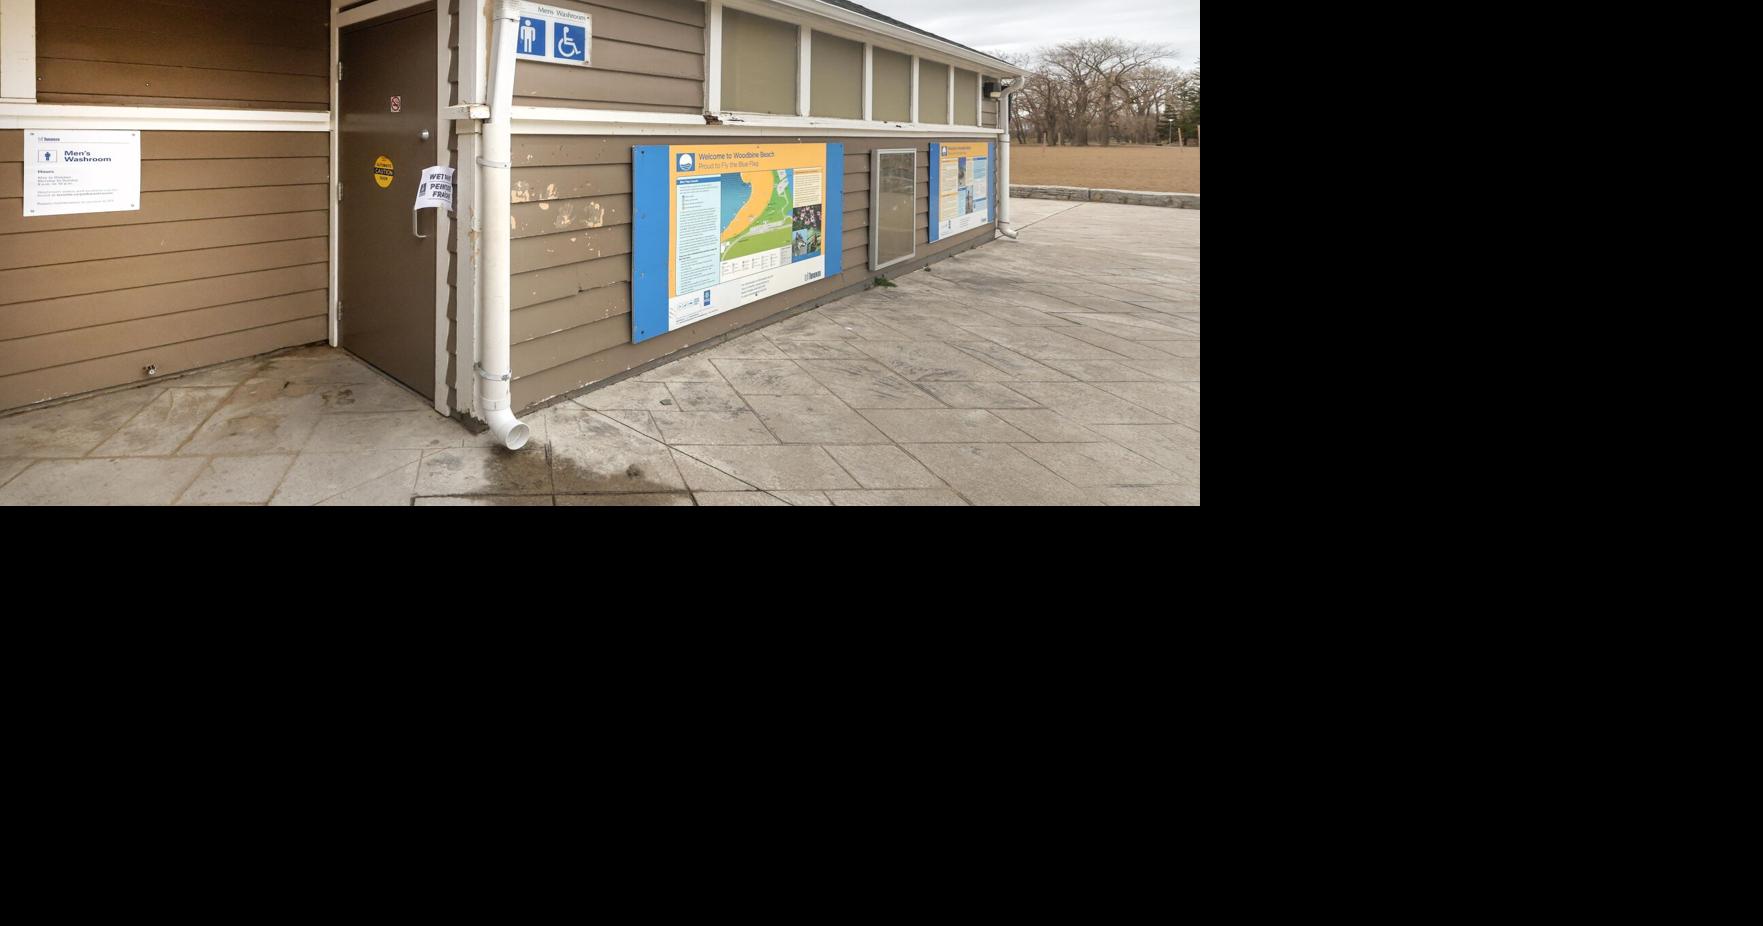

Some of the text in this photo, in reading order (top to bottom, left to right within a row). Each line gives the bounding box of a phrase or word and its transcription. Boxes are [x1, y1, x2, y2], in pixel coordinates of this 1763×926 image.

[698, 152, 725, 160] Welcome
[734, 151, 759, 159] Woodbine
[375, 167, 393, 176] CAUTION
